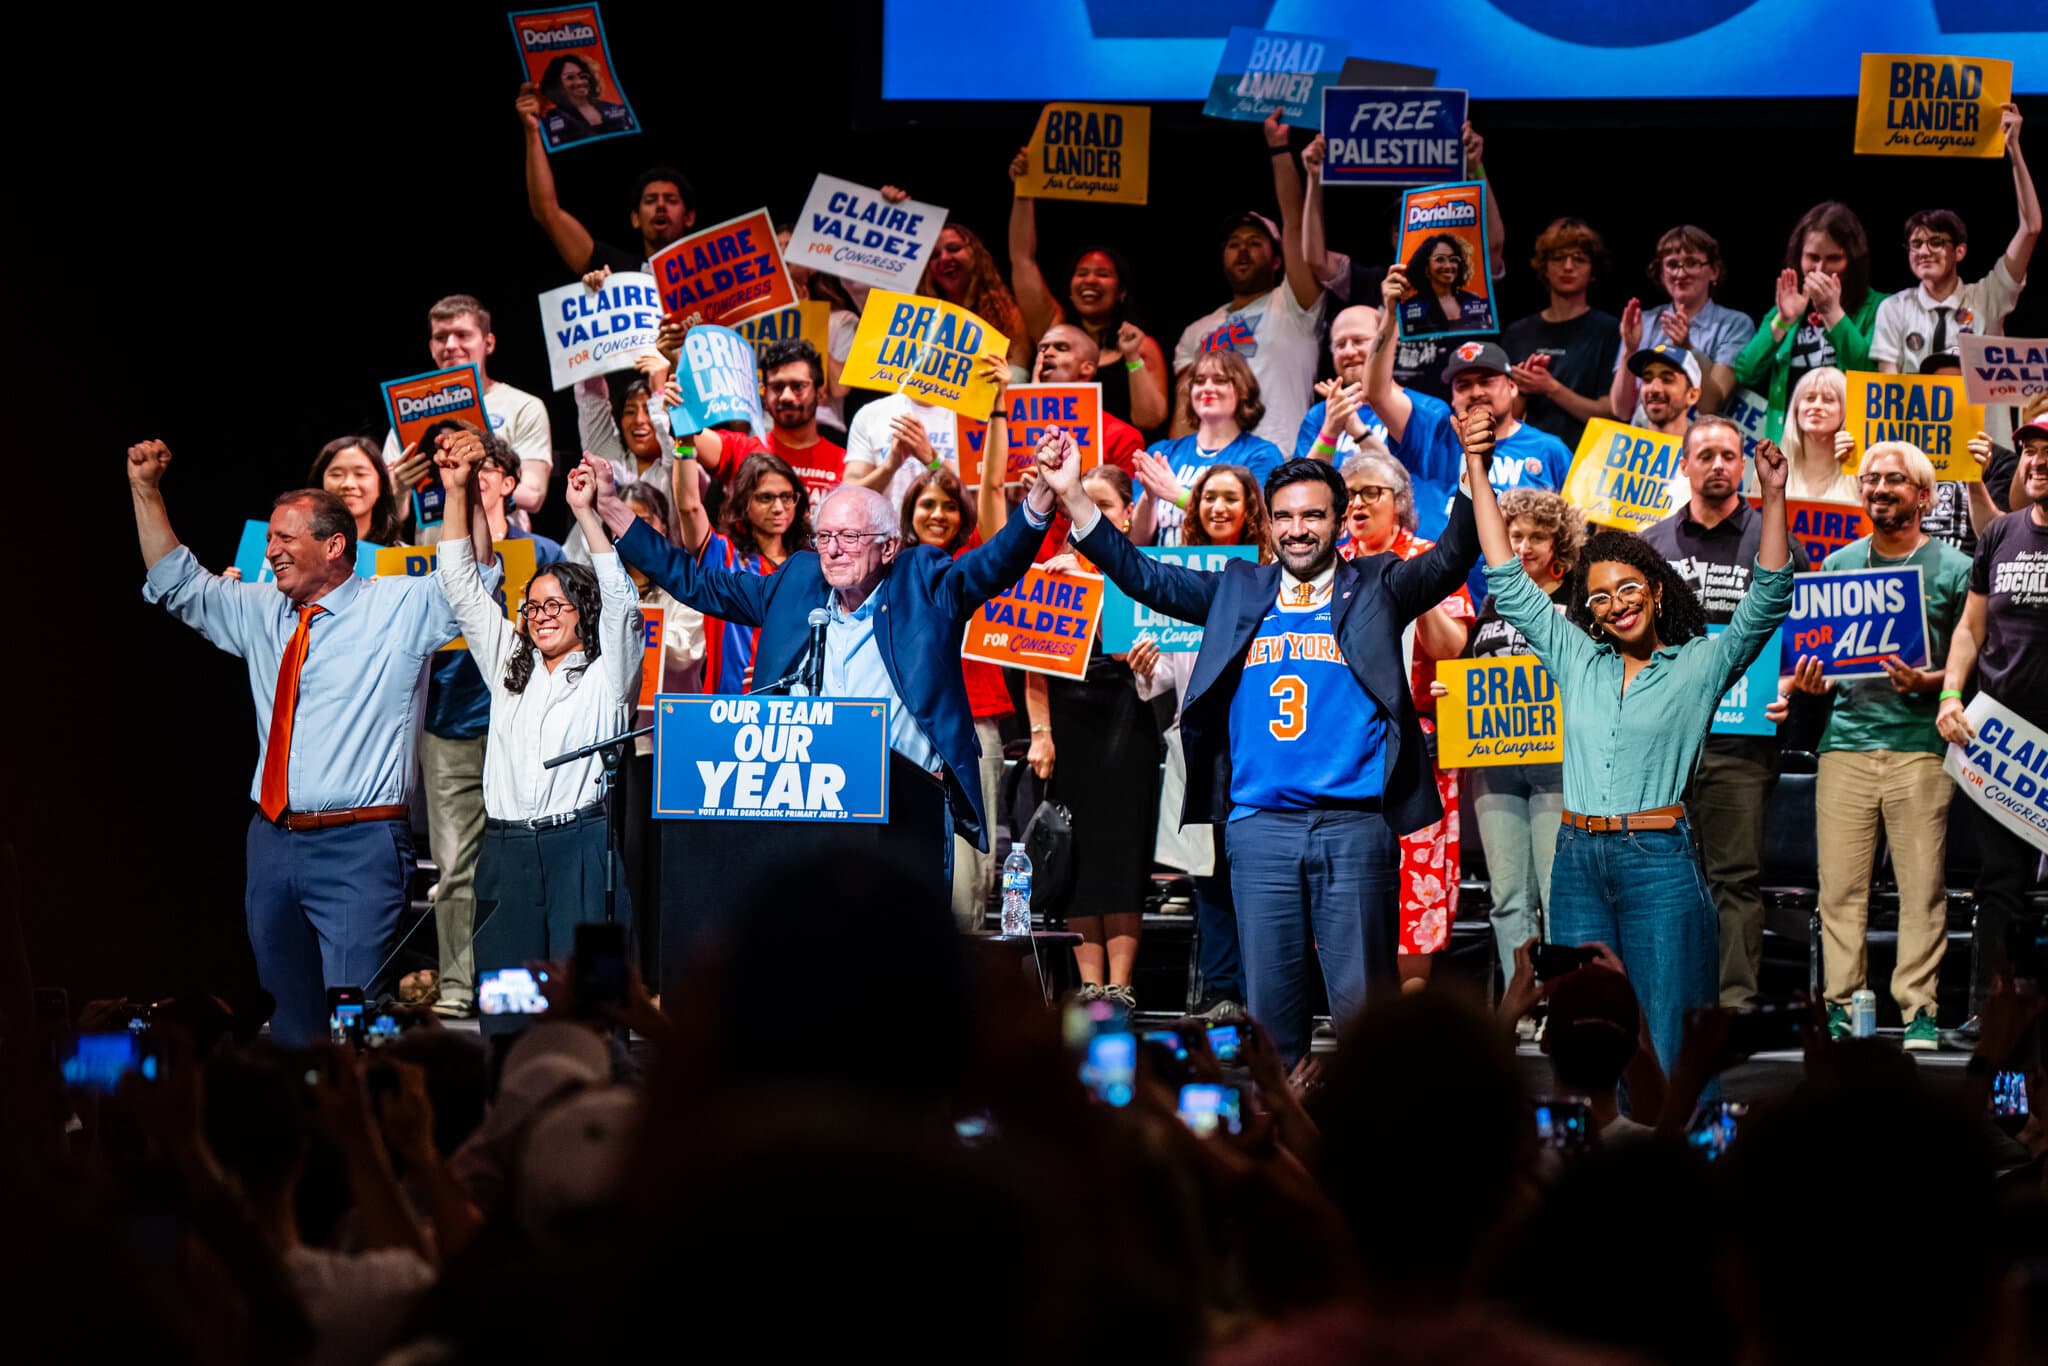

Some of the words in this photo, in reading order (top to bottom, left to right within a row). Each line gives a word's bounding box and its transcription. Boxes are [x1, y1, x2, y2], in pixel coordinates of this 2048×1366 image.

[1248, 36, 1326, 76] BRAD
[1236, 72, 1314, 105] LANDER
[1889, 62, 1983, 100] BRAD
[1044, 110, 1123, 148] BRAD
[1350, 100, 1443, 133] FREE
[1887, 99, 1980, 132] LANDER
[1328, 138, 1460, 166] PALESTINE
[1884, 131, 1910, 147] for
[1913, 131, 1976, 151] Congress
[1043, 145, 1122, 178] LANDER
[1042, 176, 1064, 190] for
[1066, 176, 1119, 196] Congress
[827, 191, 925, 237] CLAIRE
[1408, 202, 1476, 226] Darializa
[812, 213, 923, 261] VALDEZ
[664, 227, 757, 286] CLAIRE
[807, 241, 834, 256] FOR
[833, 246, 907, 273] CONGRESS
[664, 252, 778, 313] VALDEZ
[561, 284, 659, 323] CLAIRE
[680, 310, 704, 332] FOR
[703, 278, 773, 323] CONGRESS
[887, 302, 984, 356] BRAD
[567, 349, 590, 369] FOR
[592, 333, 656, 361] CONGRES
[876, 336, 973, 388] LANDER
[1983, 345, 2048, 365] CLA
[397, 386, 474, 417] Darializa
[868, 366, 893, 381] for
[896, 370, 961, 401] Congress
[1865, 381, 1954, 422] BRAD
[1988, 385, 2017, 397] FOR
[1864, 421, 1953, 456] LANDER
[1706, 573, 1736, 587] Racial
[1708, 563, 1732, 575] Jews
[1733, 564, 1750, 577] For
[1789, 578, 1906, 620] UNIONS
[984, 601, 1089, 640] VALDEZ
[1160, 627, 1204, 648] Cong
[1794, 625, 1833, 652] FOR
[1832, 617, 1901, 659] ALL
[982, 633, 1009, 647] FOR
[1009, 633, 1078, 656] CONGRESS
[1466, 664, 1555, 707] BRAD
[709, 700, 760, 724] OUR
[767, 701, 833, 725] TEAM
[1269, 674, 1308, 741] 3
[1466, 704, 1556, 740] LANDER
[733, 723, 814, 763] OUR
[1467, 742, 1491, 758] for
[1493, 739, 1556, 758] Congress
[695, 760, 847, 811] YEAR
[1961, 766, 1984, 789] FOR
[1984, 784, 2048, 833] CONGRES
[698, 808, 715, 816] VOTE
[716, 808, 725, 817] IN
[726, 809, 738, 817] THE
[740, 809, 784, 818] DEMOCRATIC
[785, 810, 818, 819] PRIMARY
[818, 810, 837, 819] JUNE
[838, 811, 848, 819] 23
